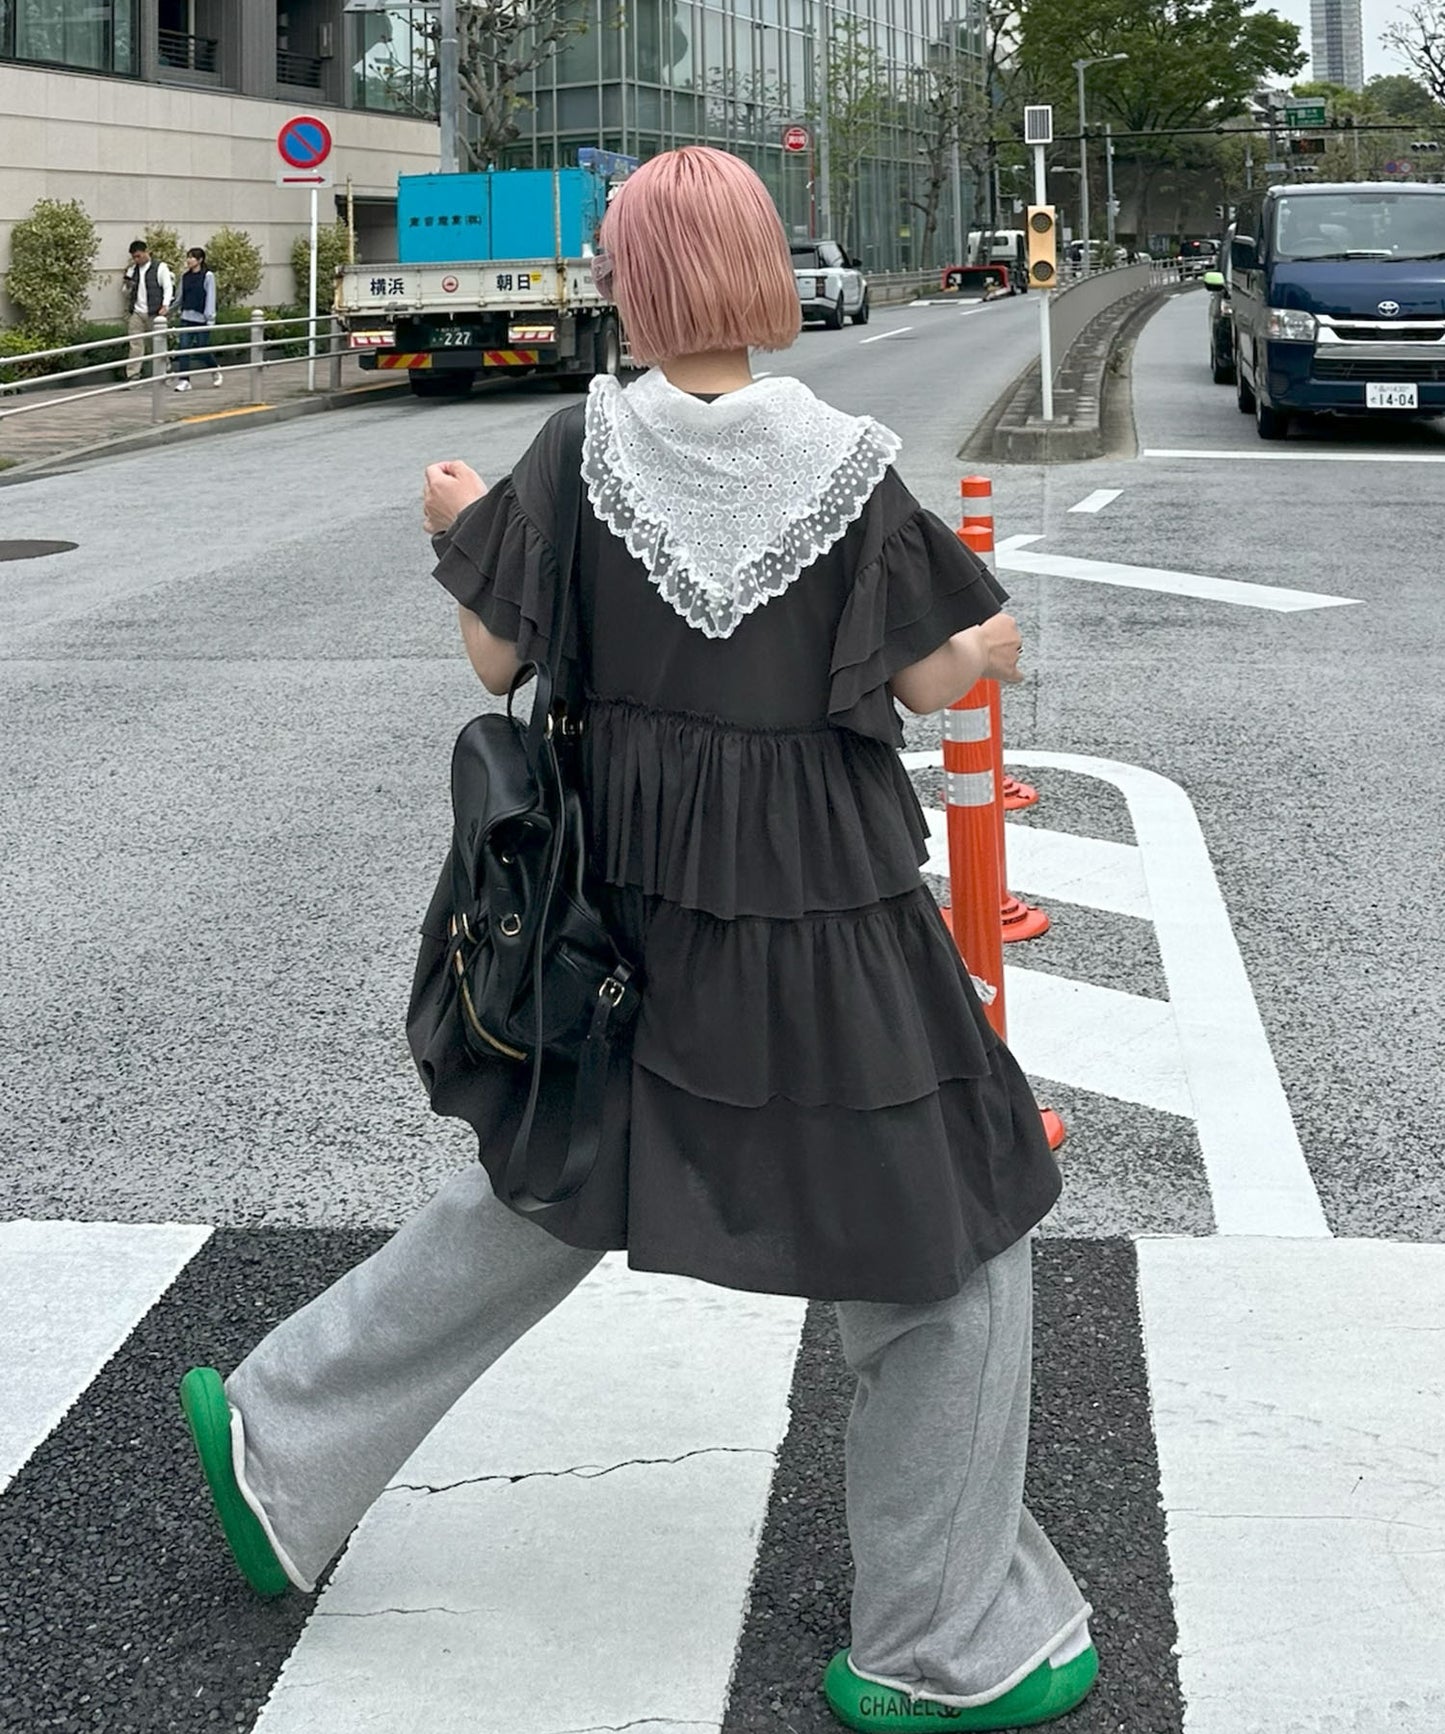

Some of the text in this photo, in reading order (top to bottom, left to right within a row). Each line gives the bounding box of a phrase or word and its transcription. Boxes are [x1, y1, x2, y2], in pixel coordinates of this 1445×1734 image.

[370, 278, 404, 295] 横浜
[497, 274, 530, 291] 朝日
[860, 1696, 938, 1718] CHANEL
